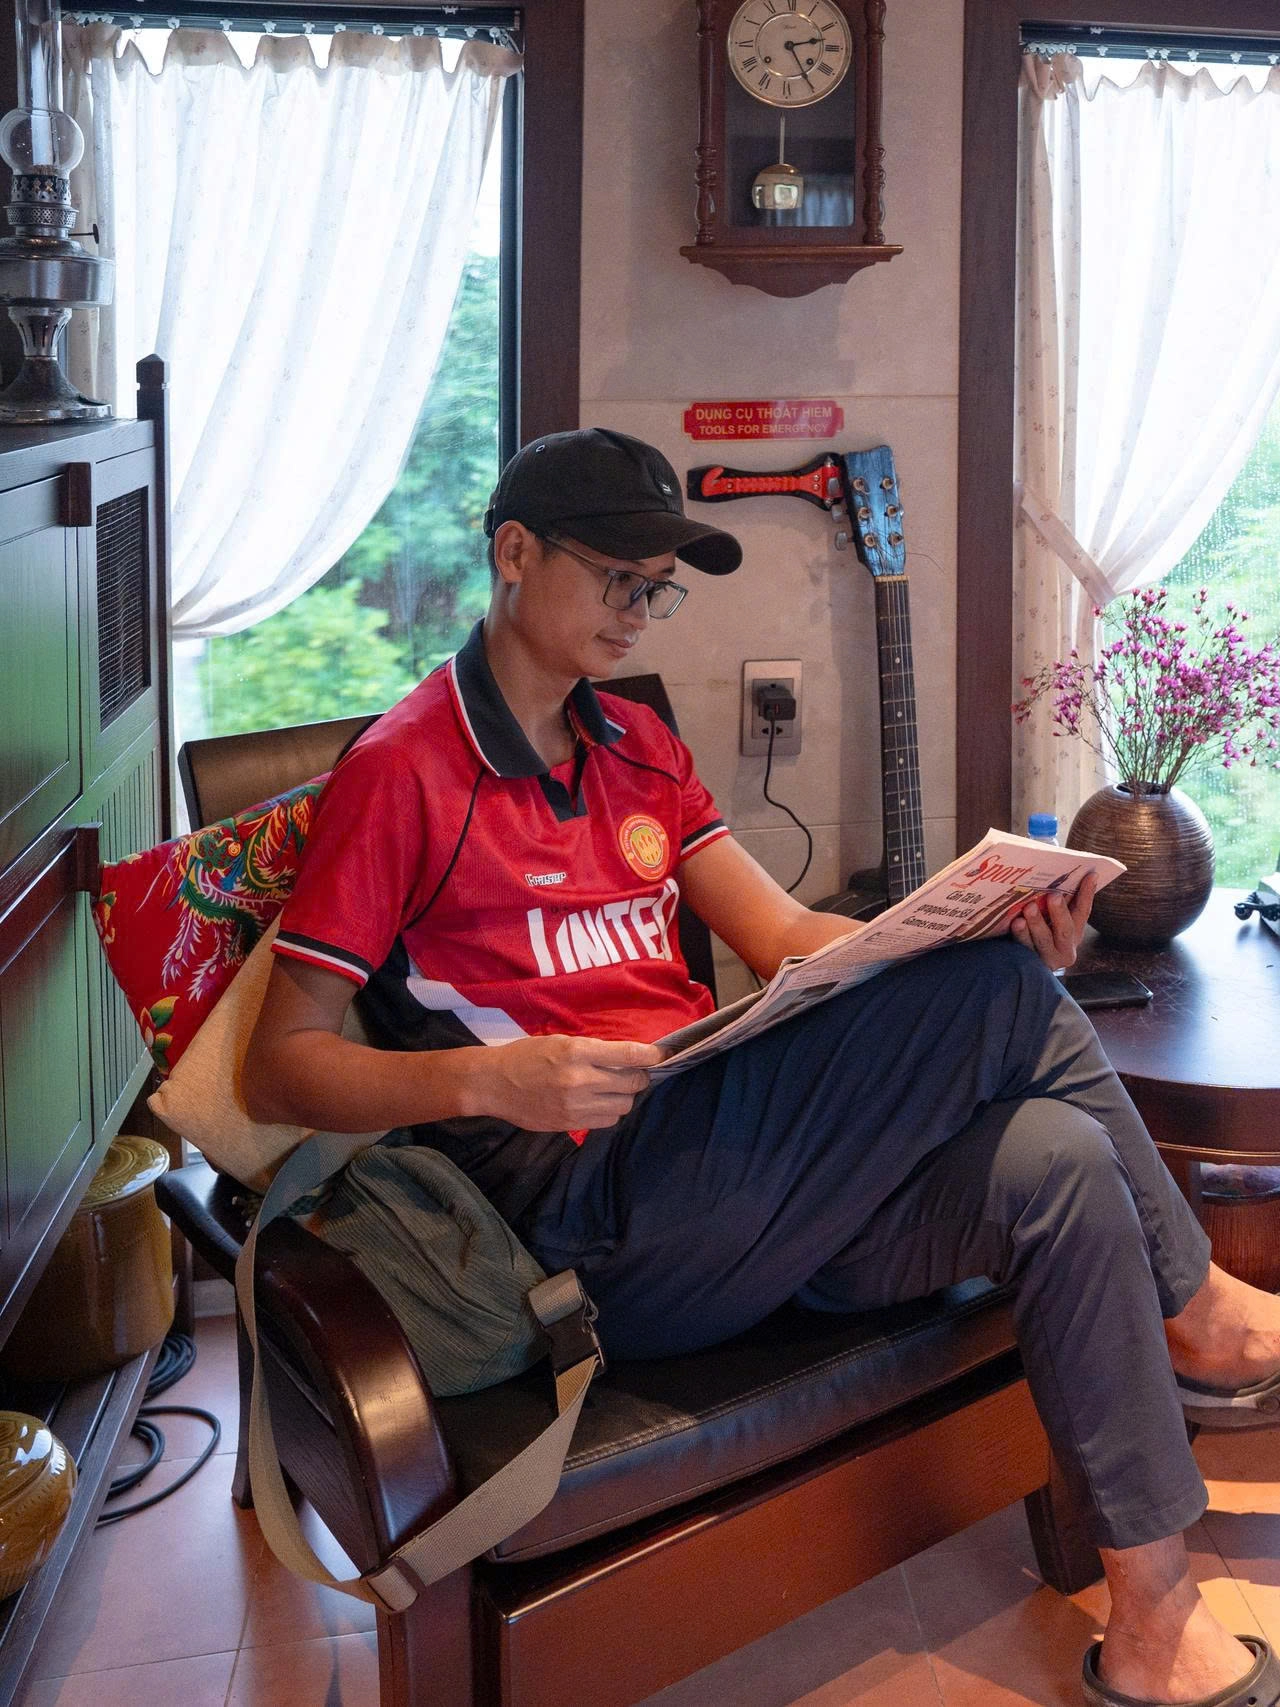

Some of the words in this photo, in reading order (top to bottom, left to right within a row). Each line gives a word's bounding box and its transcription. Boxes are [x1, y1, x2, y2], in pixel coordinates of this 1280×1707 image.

[700, 424, 736, 435] TOOLS
[737, 424, 760, 434] FOR
[762, 423, 829, 434] EMERGENCY
[964, 855, 1034, 885] Sport
